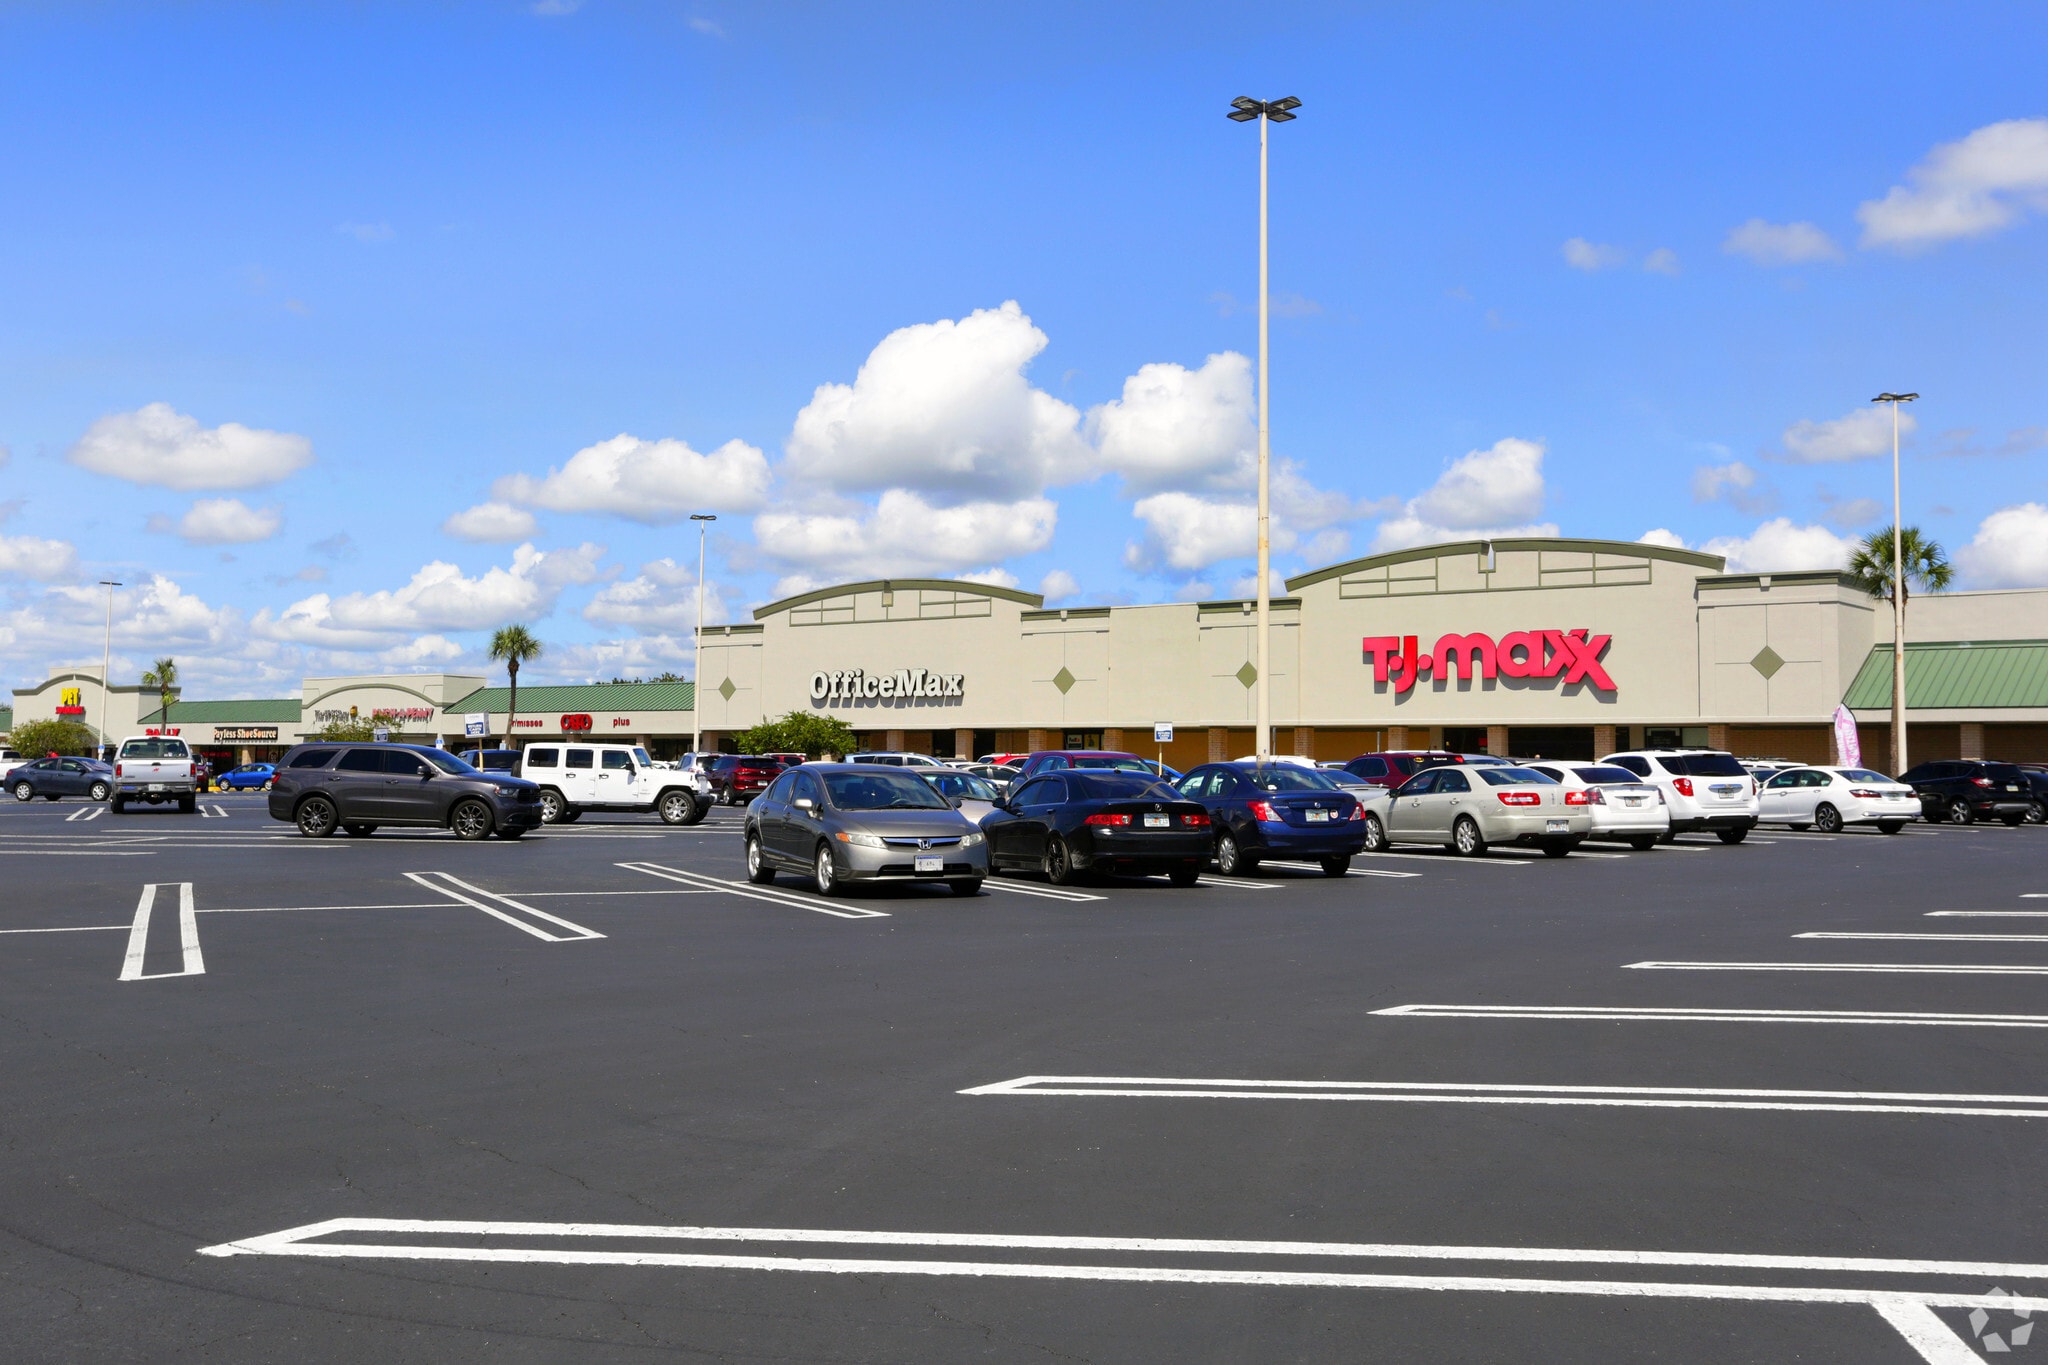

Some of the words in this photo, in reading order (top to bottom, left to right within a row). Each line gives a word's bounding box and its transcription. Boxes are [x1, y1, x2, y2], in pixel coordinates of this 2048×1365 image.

[809, 669, 963, 699] OfficeMax
[61, 687, 79, 705] PET
[613, 717, 630, 728] plus
[146, 728, 181, 736] SALY
[213, 729, 236, 740] Payless
[237, 729, 277, 739] ShoeSource
